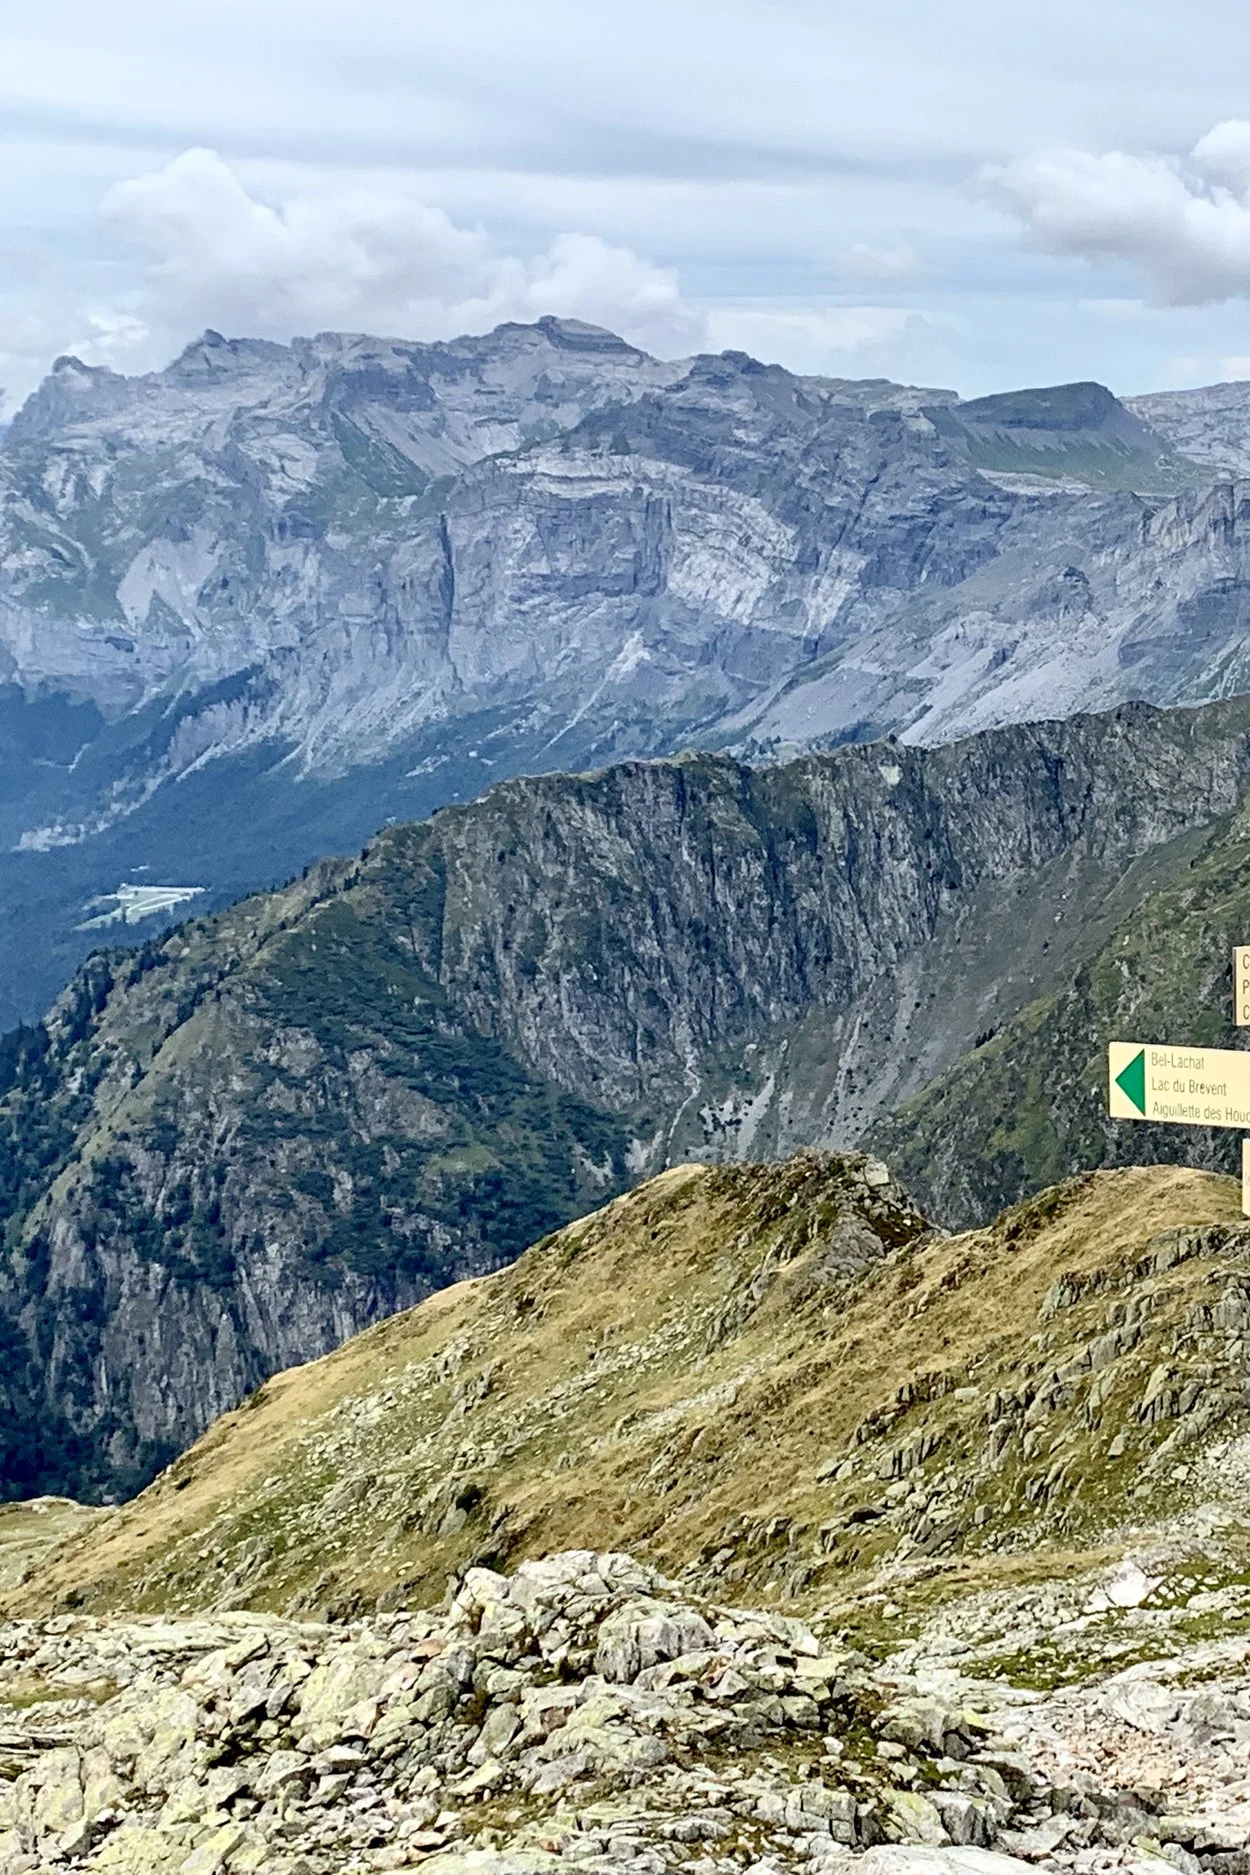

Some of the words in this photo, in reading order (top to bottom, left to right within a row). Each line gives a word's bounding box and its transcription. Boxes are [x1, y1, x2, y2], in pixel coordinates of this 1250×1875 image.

[1152, 1052, 1204, 1070] Bel-Lachat
[1152, 1076, 1170, 1092] Lac
[1173, 1078, 1185, 1093] du
[1188, 1079, 1227, 1096] Brévent
[1152, 1102, 1200, 1120] Aiguillette
[1204, 1106, 1222, 1120] des
